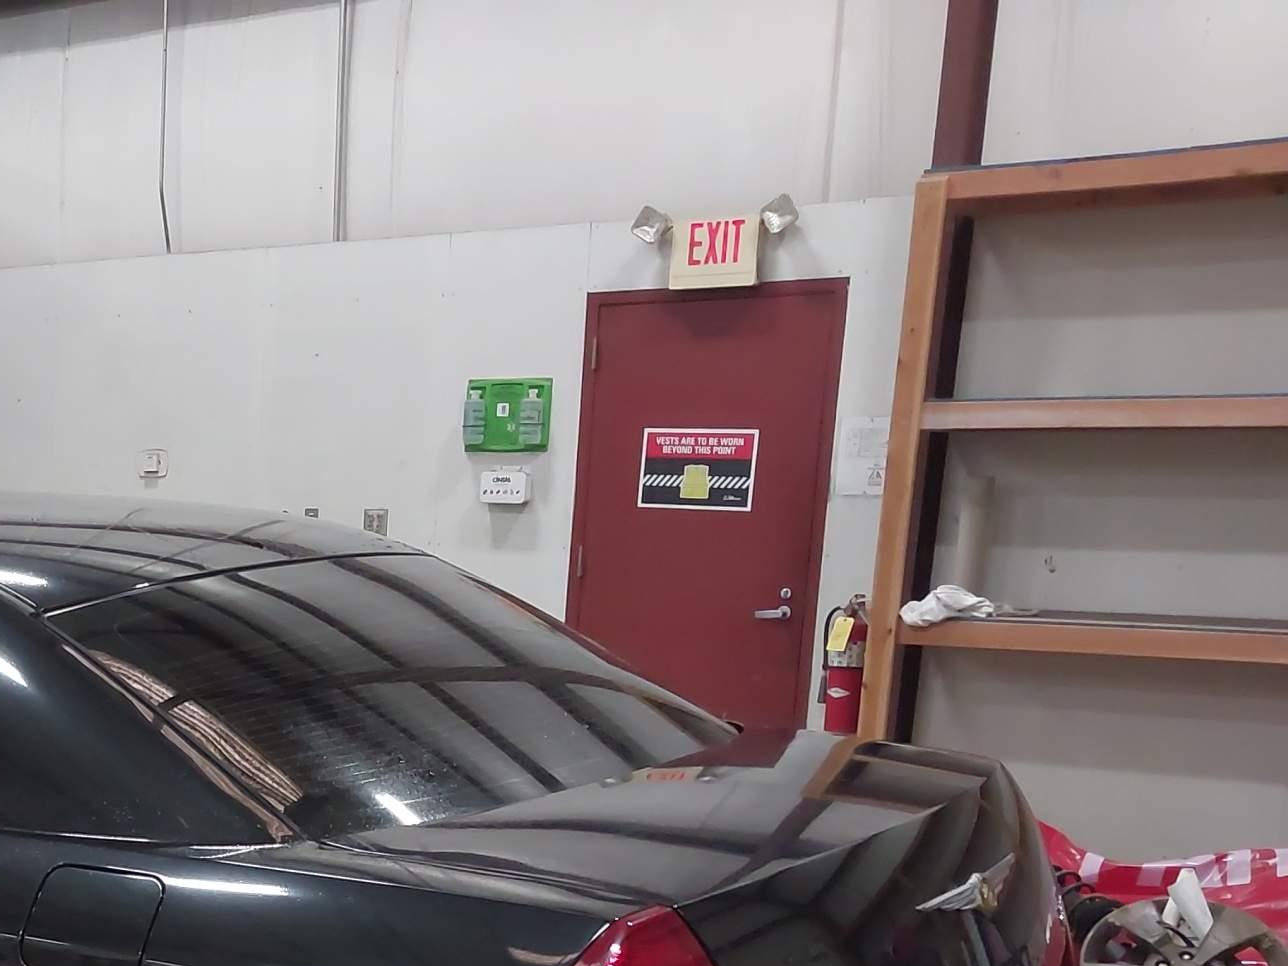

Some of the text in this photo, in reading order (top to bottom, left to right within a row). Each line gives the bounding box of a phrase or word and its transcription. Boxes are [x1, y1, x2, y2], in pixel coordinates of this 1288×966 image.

[688, 219, 746, 266] EXIT
[656, 436, 745, 447] VESTS ARE TO BE WORN
[662, 445, 736, 456] BEYOND THIS POINT
